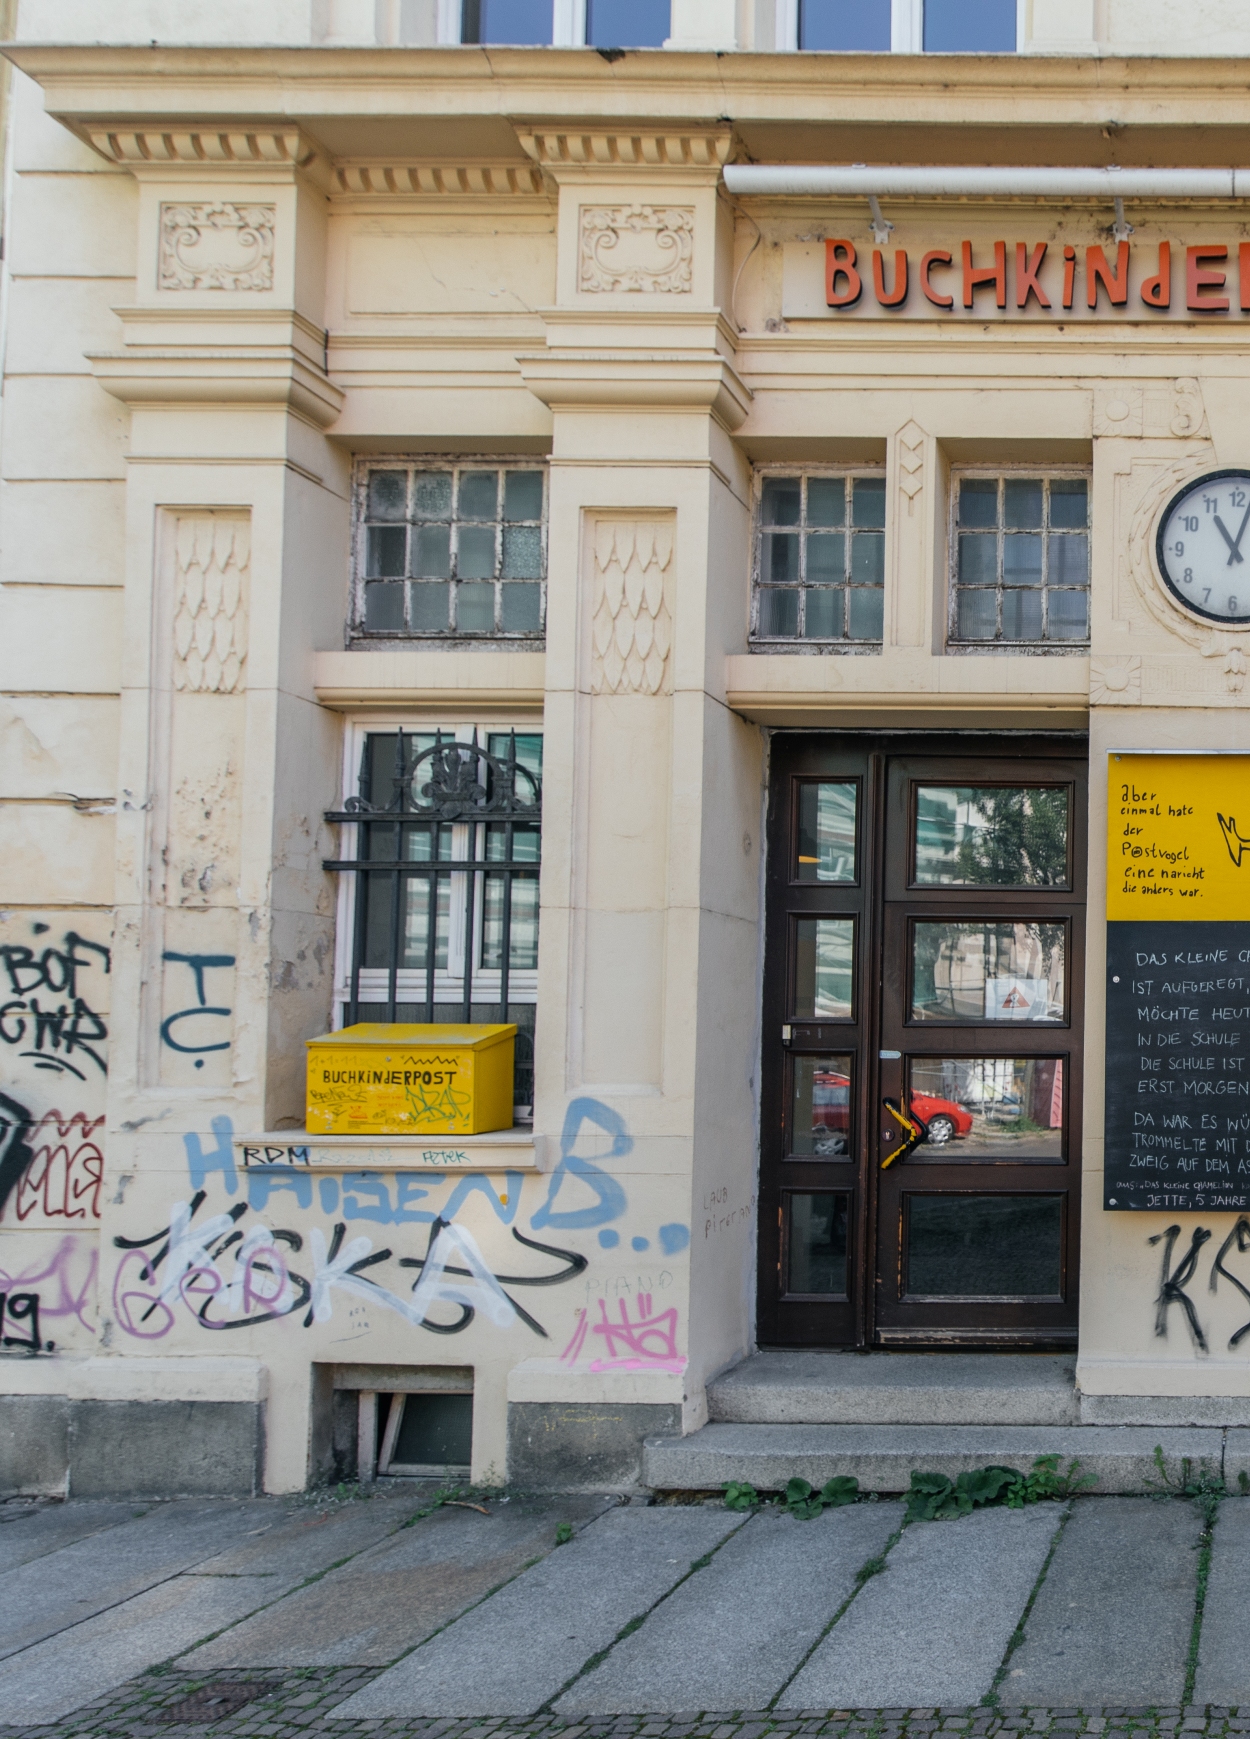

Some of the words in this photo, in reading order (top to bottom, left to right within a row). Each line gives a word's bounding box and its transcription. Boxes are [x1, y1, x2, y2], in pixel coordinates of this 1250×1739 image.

[1204, 497, 1218, 514] 11
[1229, 491, 1246, 507] 12
[1183, 516, 1199, 532] 10
[1174, 541, 1184, 557] 9
[1183, 568, 1193, 584] 8
[1202, 588, 1212, 604] 7
[1228, 595, 1238, 612] 6
[1120, 803, 1162, 816] einmal
[1122, 823, 1144, 836] der
[1161, 865, 1206, 880] naricht
[1122, 881, 1137, 894] die
[1141, 884, 1174, 897] anders
[1179, 888, 1204, 898] war.
[1136, 952, 1167, 967] DAS
[1174, 949, 1229, 964] KLEINE
[1132, 980, 1154, 995] IST
[1161, 977, 1250, 995] AUFGEREGT,
[1138, 1005, 1200, 1022] MÖCHTE
[1138, 1033, 1151, 1047] IN
[1157, 1033, 1182, 1046] DIE
[1190, 1032, 1241, 1047] SCHULE
[1141, 1057, 1161, 1071] DIE
[1168, 1057, 1215, 1071] SCHULE
[1223, 1057, 1245, 1071] IST
[1138, 1078, 1176, 1093] ERST
[1134, 1111, 1155, 1126] DA
[1163, 1114, 1192, 1129] WAR
[1201, 1114, 1218, 1129] ES
[1132, 1132, 1207, 1151] TROMMELTE
[1216, 1138, 1238, 1154] MIT
[243, 1146, 311, 1166] RDM
[1129, 1154, 1169, 1170] ZWEIG
[1177, 1157, 1199, 1172] AUF
[1206, 1158, 1230, 1174] DEM
[1147, 1194, 1192, 1208] JETTE,
[1196, 1194, 1205, 1206] 5
[1210, 1195, 1247, 1206] JAHRE
